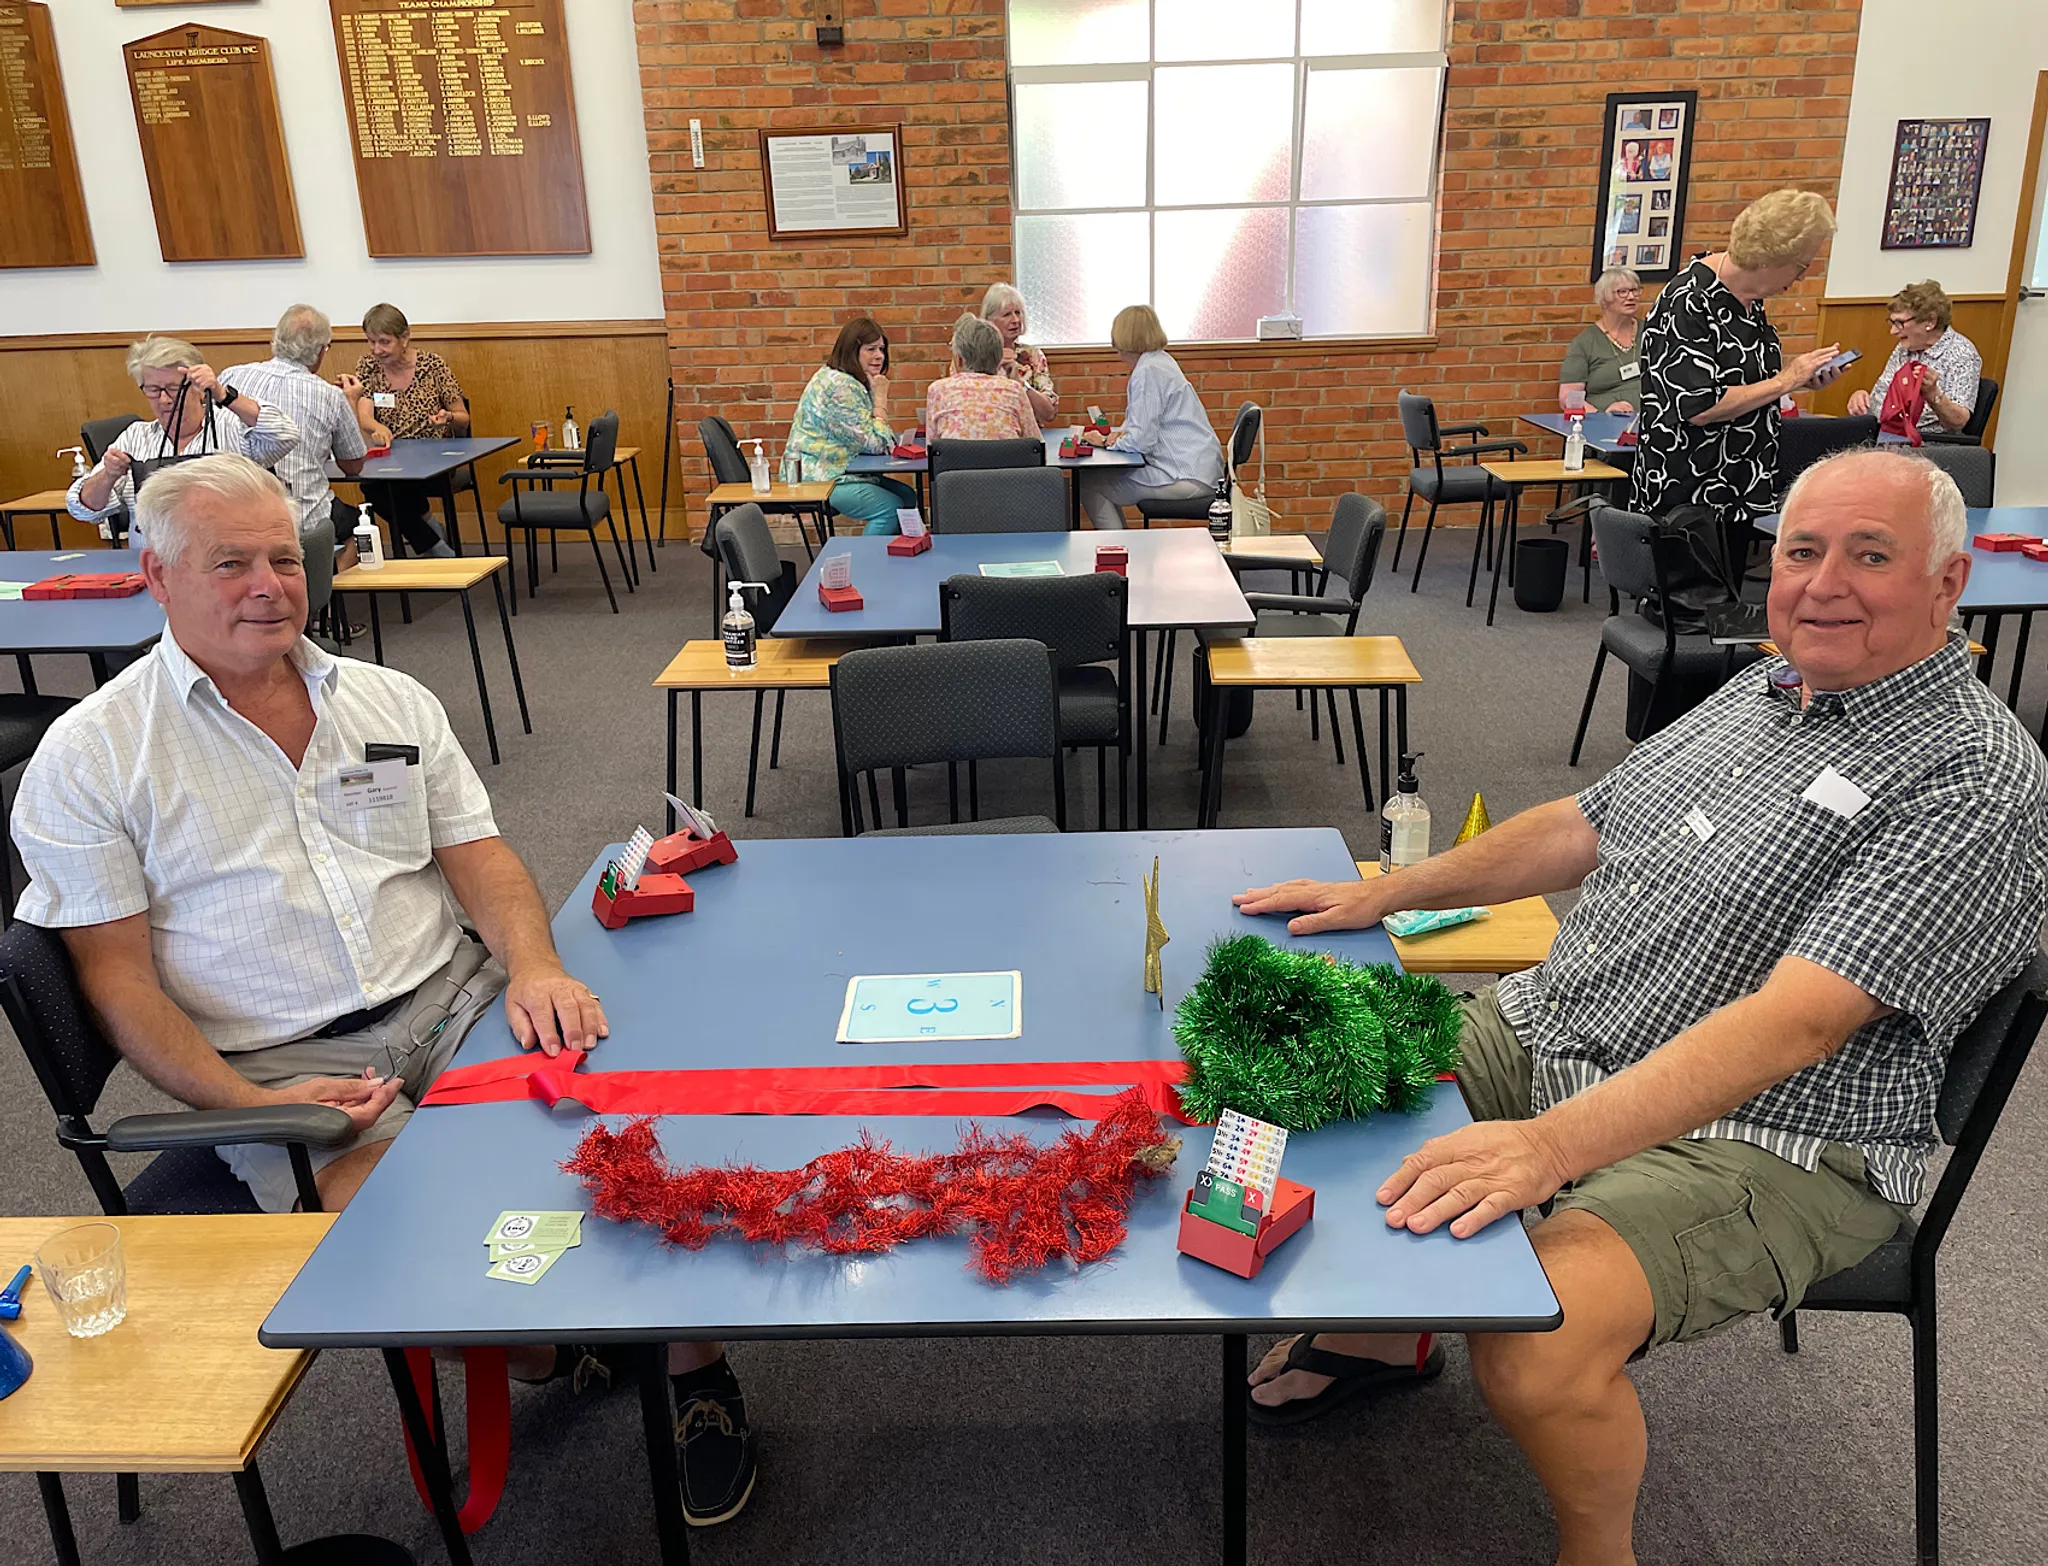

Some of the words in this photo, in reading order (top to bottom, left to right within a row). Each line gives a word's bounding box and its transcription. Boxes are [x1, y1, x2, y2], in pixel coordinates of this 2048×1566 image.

[134, 50, 187, 59] LAUNCESTON
[188, 48, 219, 57] BRIDGE
[220, 47, 241, 55] CLUB
[927, 979, 941, 988] W
[860, 1003, 876, 1011] S
[907, 998, 958, 1015] 3
[990, 1000, 1006, 1008] N
[920, 1026, 936, 1034] E
[1215, 1183, 1237, 1197] PASS
[1248, 1192, 1257, 1204] X
